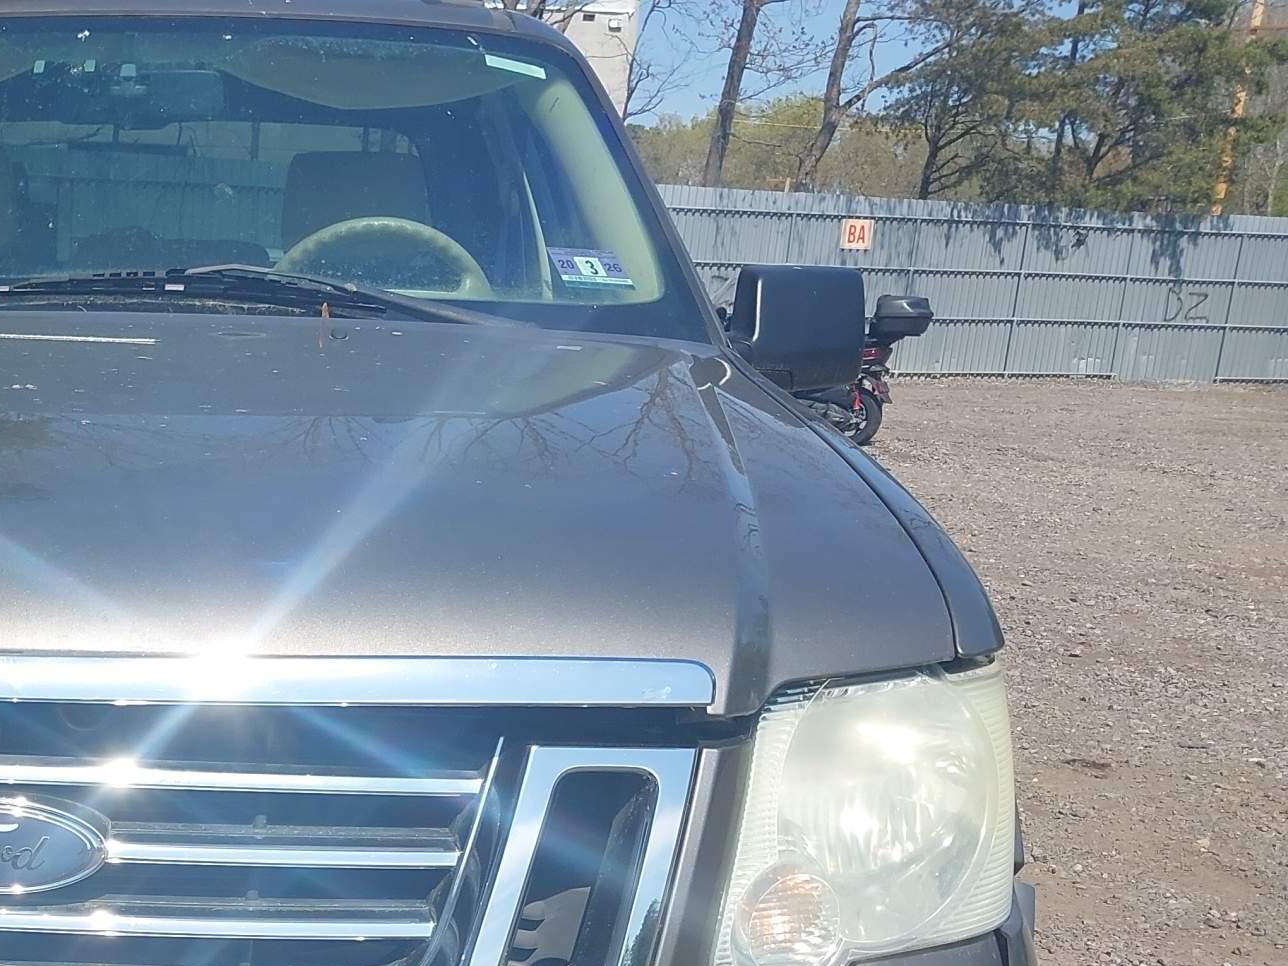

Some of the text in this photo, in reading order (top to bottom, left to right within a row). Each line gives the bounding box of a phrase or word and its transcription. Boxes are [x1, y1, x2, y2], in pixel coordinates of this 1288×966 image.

[847, 224, 866, 244] BA
[558, 259, 623, 275] 20 3 26
